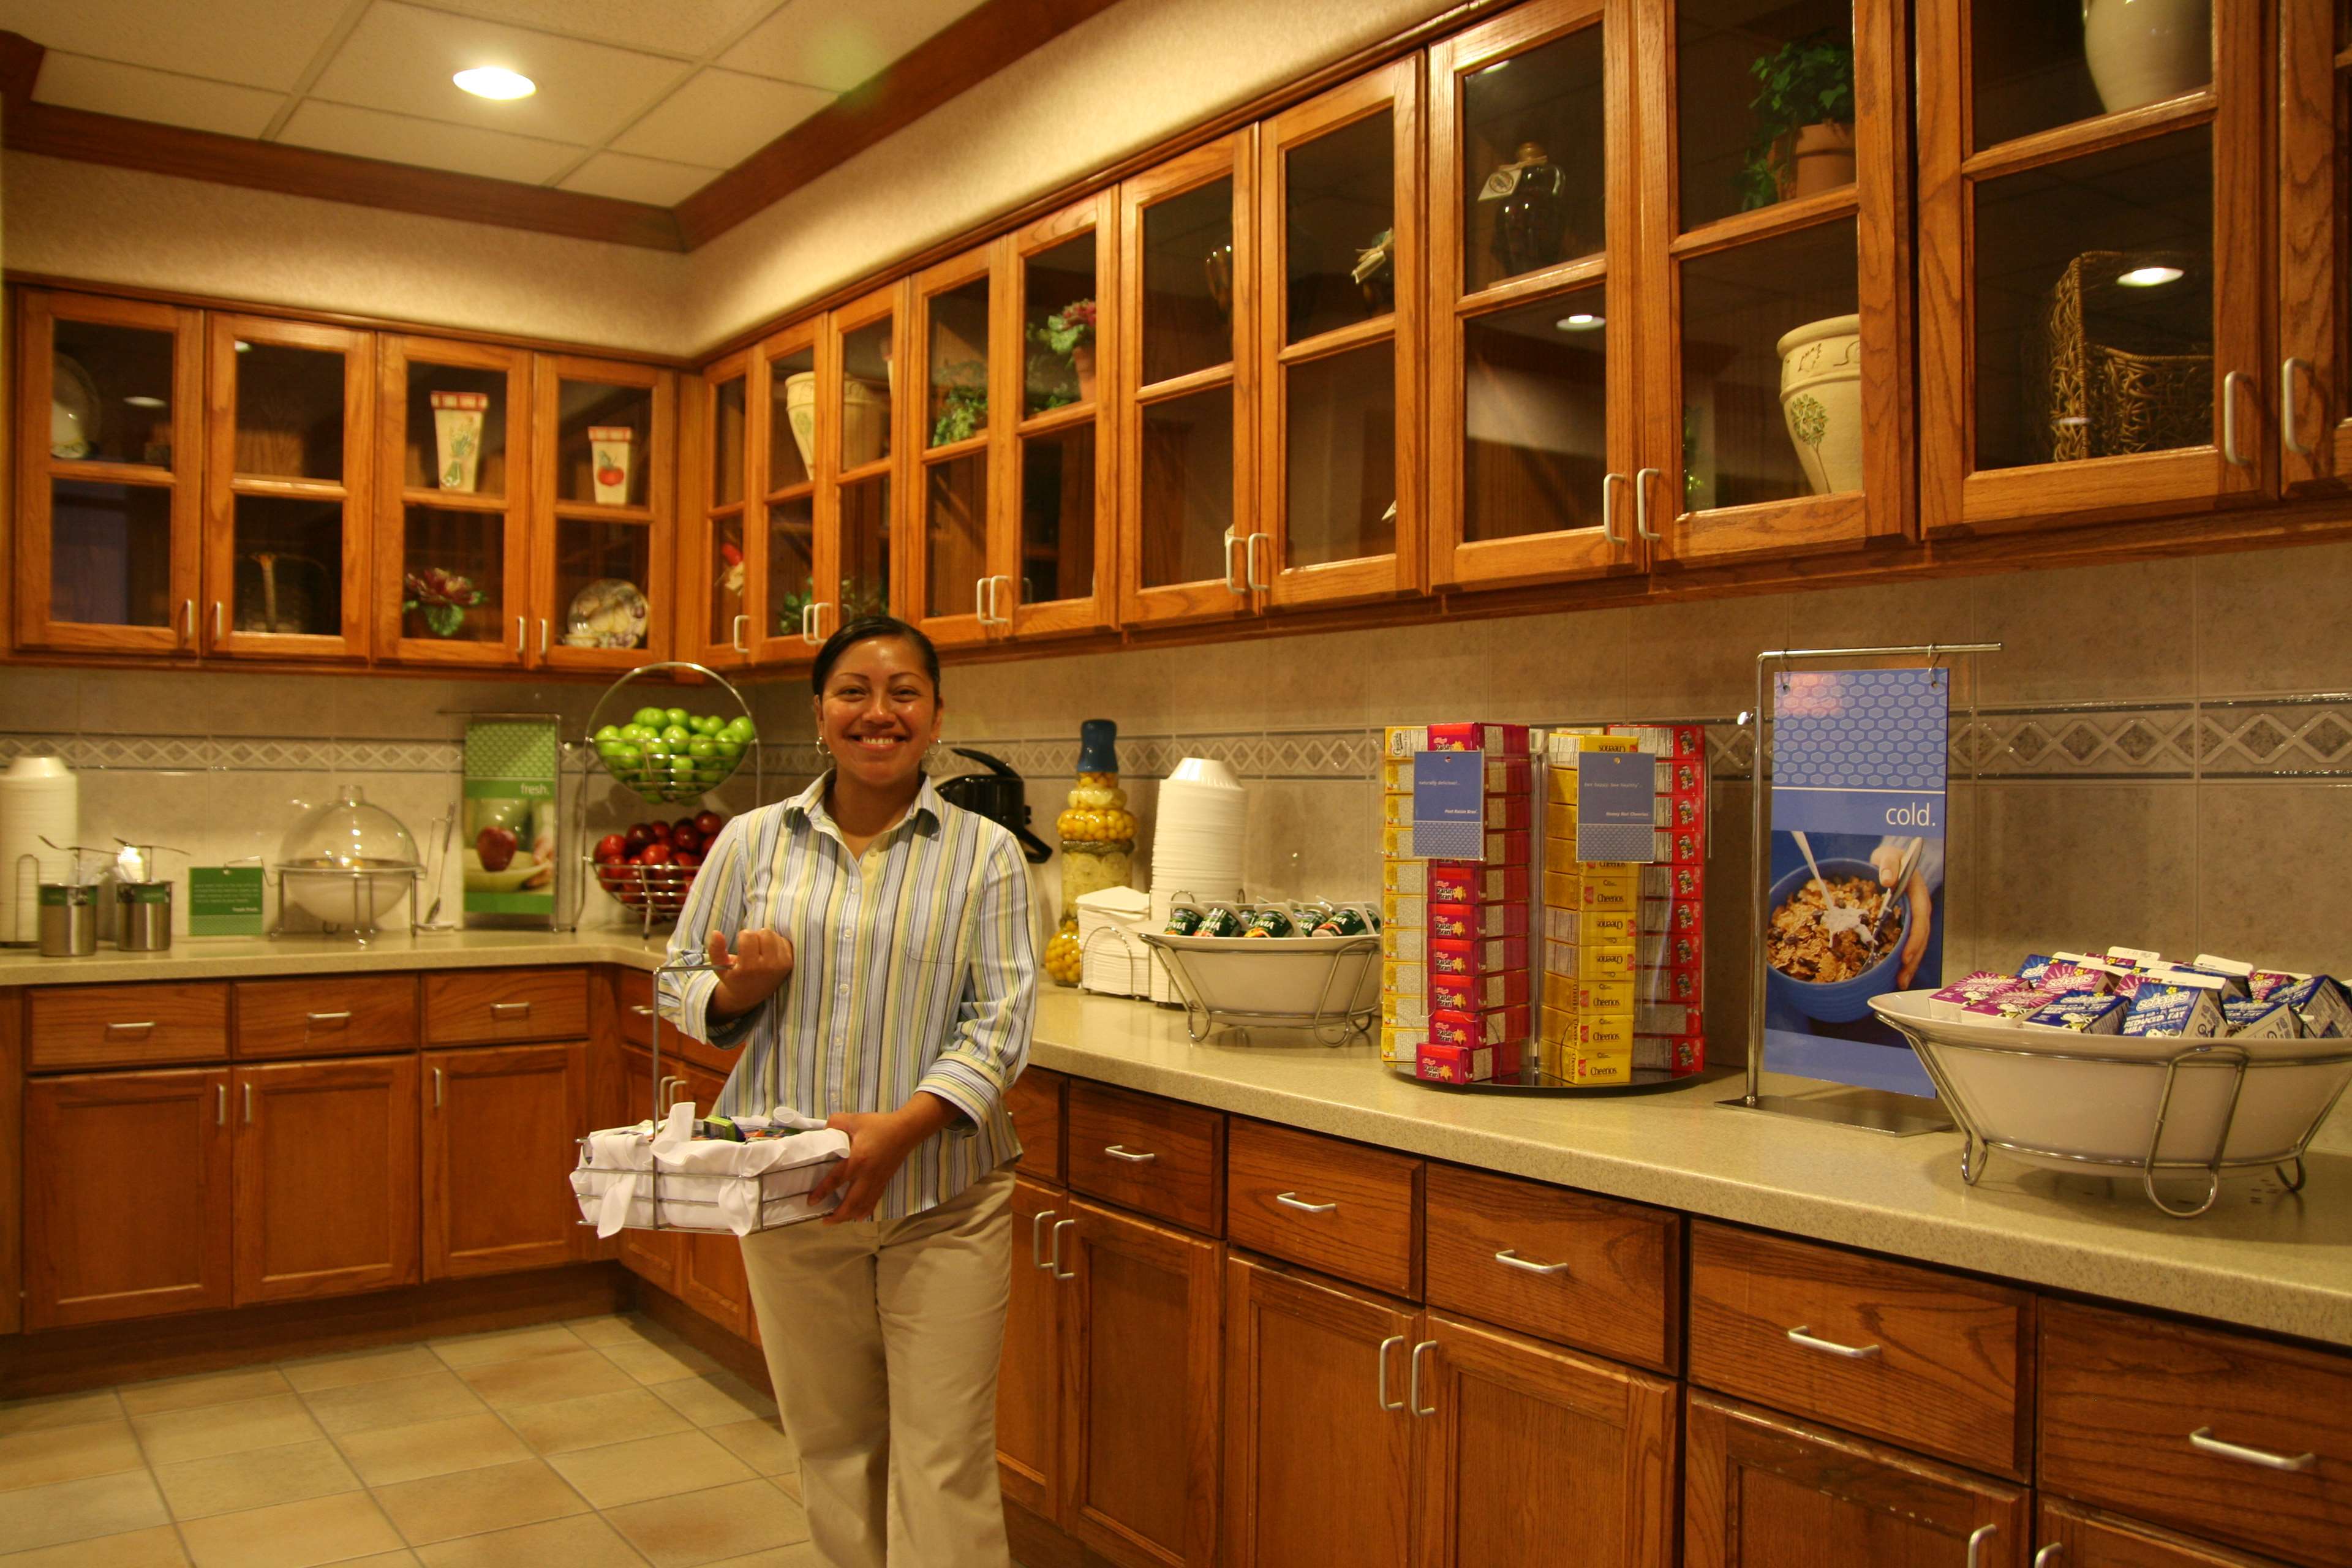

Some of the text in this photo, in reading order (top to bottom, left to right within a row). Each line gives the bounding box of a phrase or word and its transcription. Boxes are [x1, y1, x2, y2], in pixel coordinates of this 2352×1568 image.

[520, 783, 549, 794] fresh.
[1886, 802, 1936, 826] cold.
[1597, 894, 1624, 902] Cheerios
[1597, 921, 1623, 930] Cheerios
[1597, 956, 1623, 965] Cheerios
[2022, 963, 2050, 979] sche
[2045, 973, 2095, 990] schepps
[1593, 997, 1620, 1006] Cheerios
[2136, 991, 2190, 1011] schepps
[2124, 1015, 2165, 1027] REDUCED
[2167, 1011, 2185, 1020] FAT
[2123, 1025, 2143, 1035] MILK
[1593, 1032, 1619, 1041] Cheerios
[1423, 1064, 1441, 1073] Raisin
[1591, 1067, 1617, 1076] Cheerios
